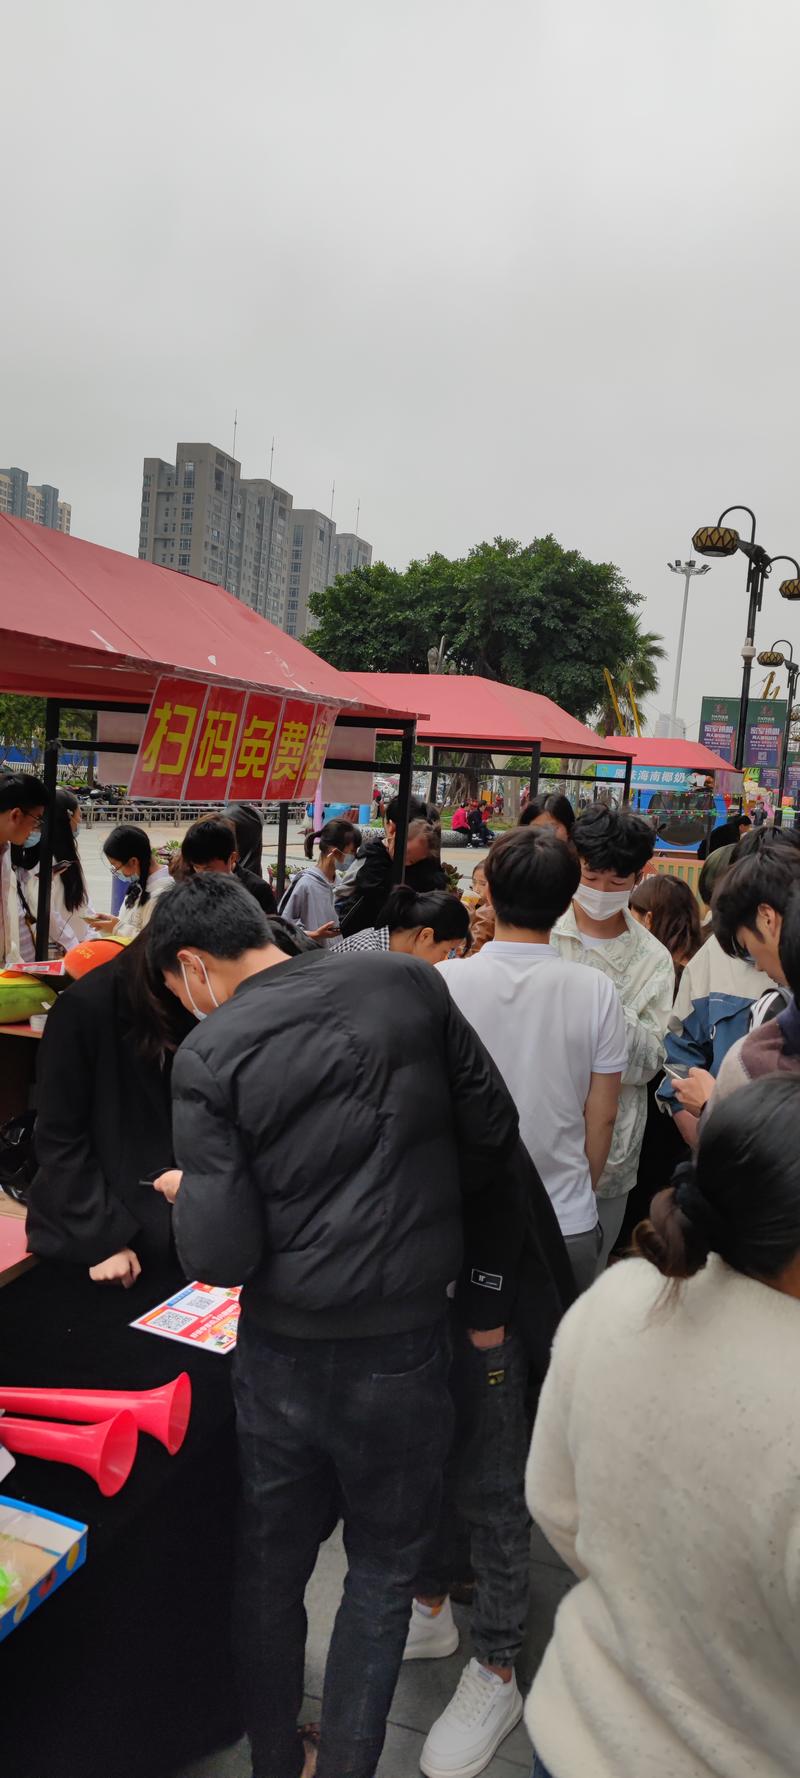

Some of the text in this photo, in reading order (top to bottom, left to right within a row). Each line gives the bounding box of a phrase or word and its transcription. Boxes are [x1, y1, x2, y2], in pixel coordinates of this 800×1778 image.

[143, 702, 330, 780] 扫码免费送
